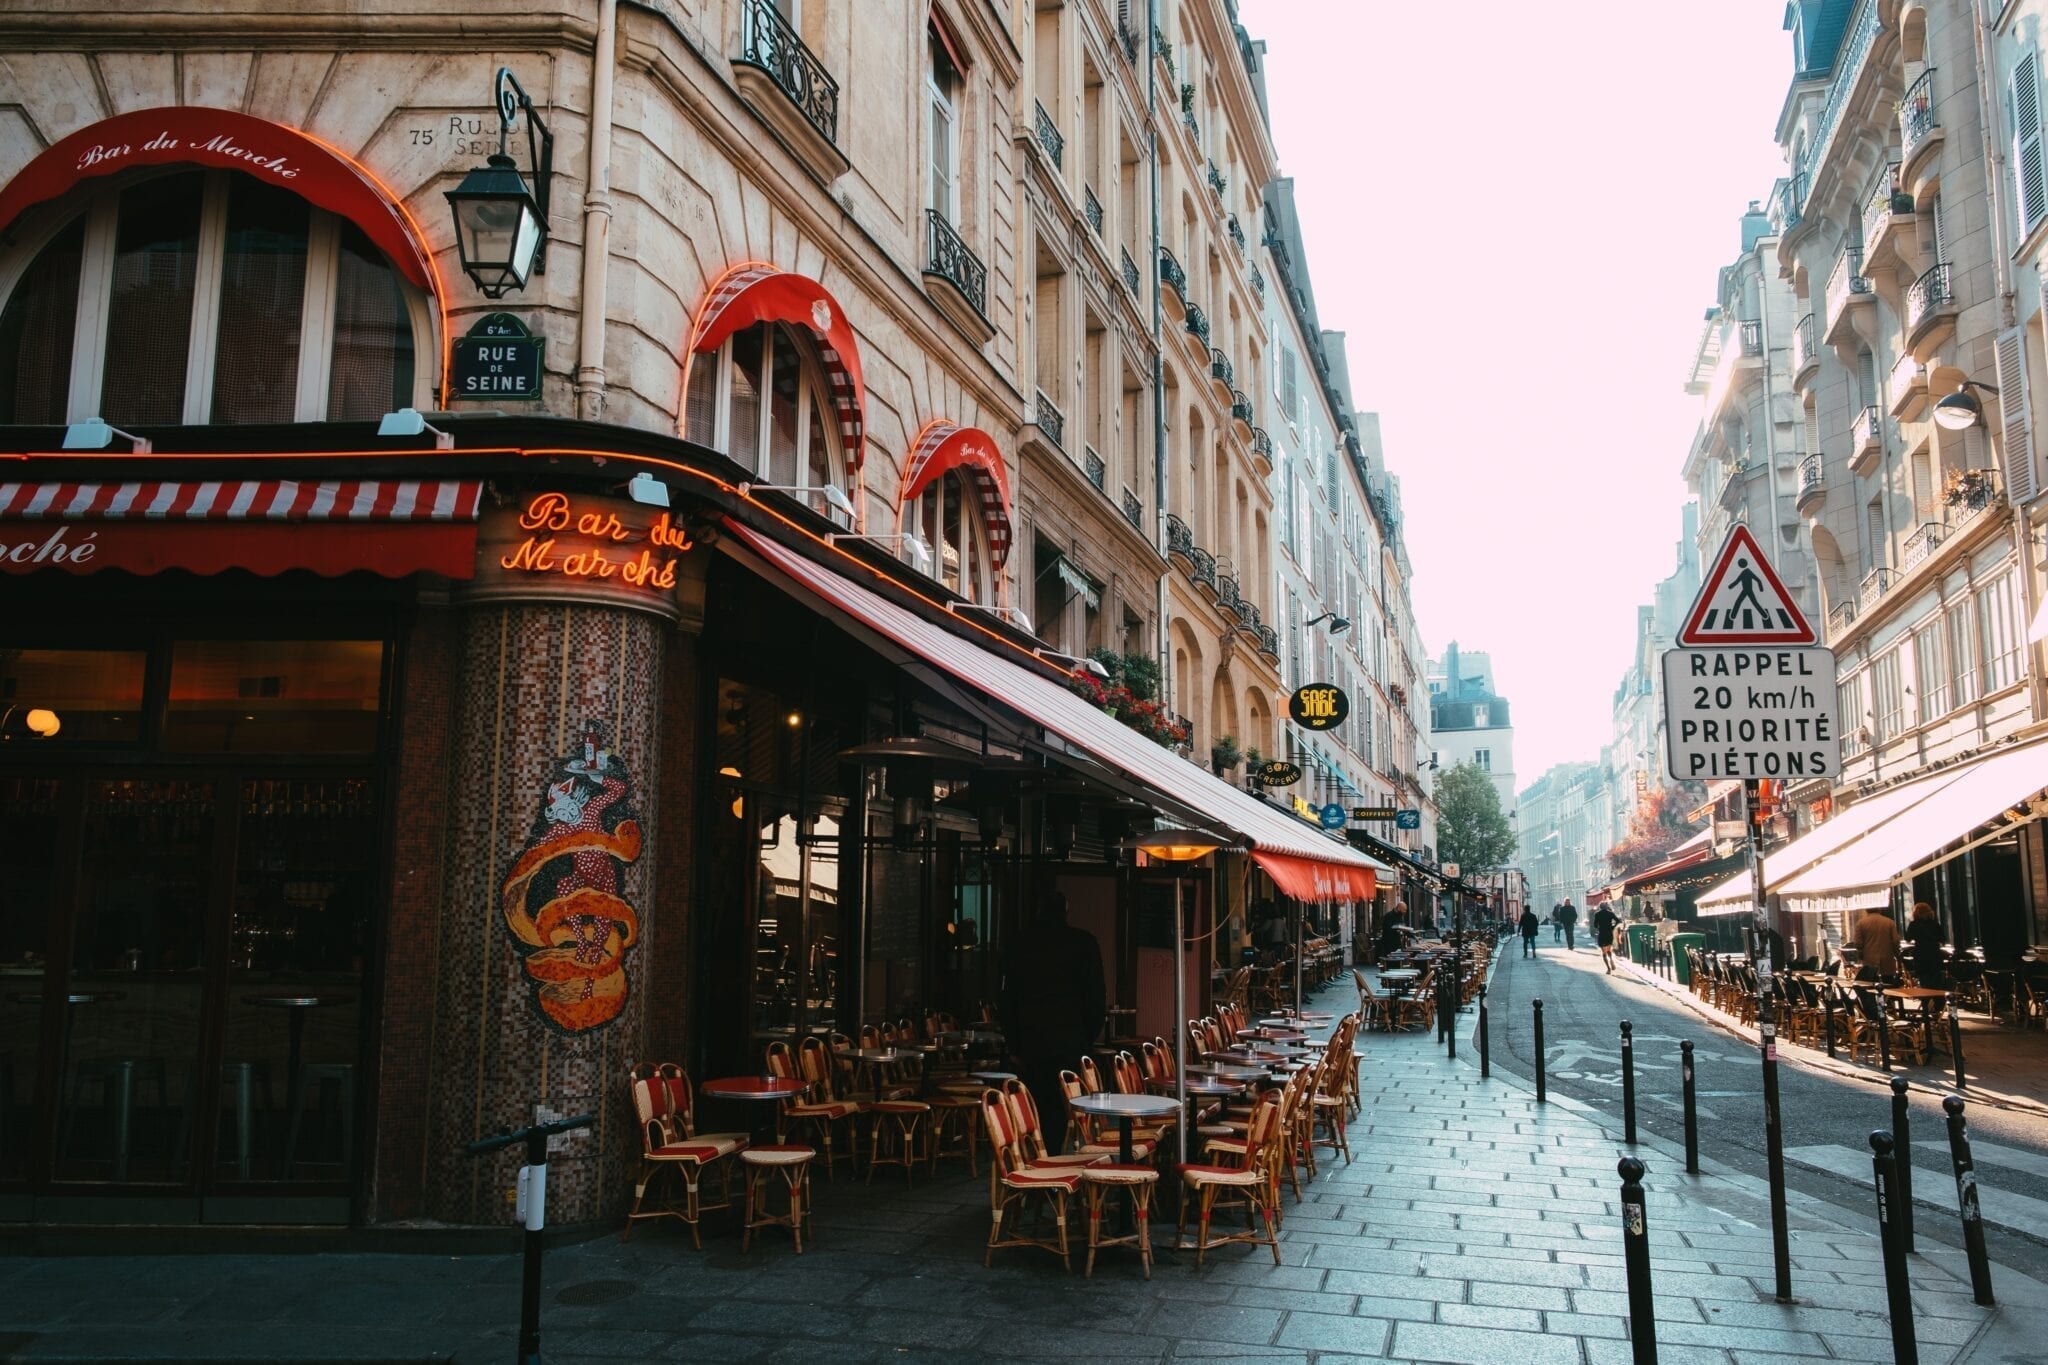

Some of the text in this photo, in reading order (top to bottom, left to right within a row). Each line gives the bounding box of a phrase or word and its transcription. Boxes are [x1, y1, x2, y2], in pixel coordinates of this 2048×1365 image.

[409, 130, 433, 145] 75
[76, 131, 300, 179] Bar du Marché
[478, 347, 517, 361] RUE
[466, 376, 526, 391] SEINE
[519, 492, 693, 550] Bar du
[501, 536, 678, 589] Marché
[1690, 653, 1813, 676] RAPPEL
[1693, 685, 1815, 709] 20 km/h
[1681, 713, 1830, 742] PRIORITÉ
[1690, 747, 1827, 776] PIÉTONS
